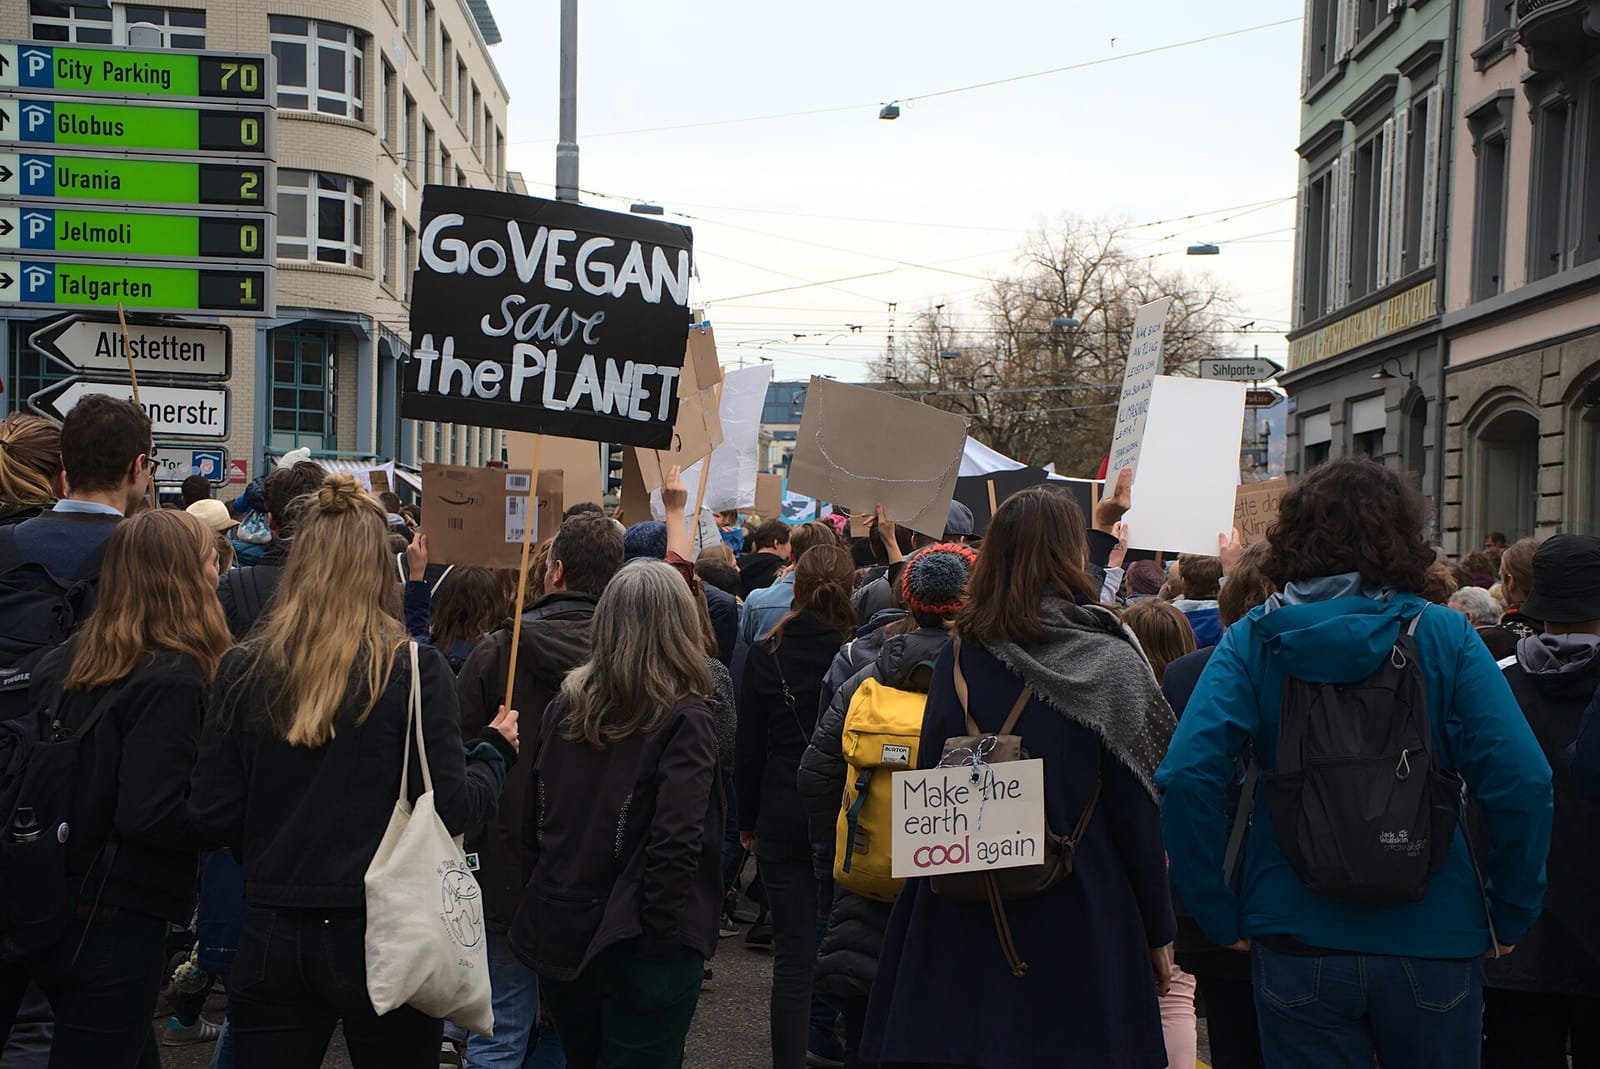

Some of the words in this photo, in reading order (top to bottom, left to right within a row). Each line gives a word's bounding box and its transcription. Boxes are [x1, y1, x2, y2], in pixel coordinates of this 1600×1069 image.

[57, 58, 93, 85] City
[103, 61, 171, 89] Parking
[220, 63, 258, 92] 70
[58, 113, 125, 136] Globus
[241, 118, 258, 145] 0
[58, 167, 121, 190] Urania
[240, 172, 258, 199] 2
[59, 221, 132, 244] Jelmoli
[240, 225, 258, 252] 0
[59, 274, 152, 300] Talgarten
[239, 277, 257, 304] 1
[95, 331, 206, 362] Altstetten
[412, 333, 504, 398] the
[510, 342, 680, 422] PLANET
[1212, 364, 1256, 378] Sihlporte
[904, 776, 969, 810] Make
[979, 770, 1022, 801] the
[904, 807, 968, 835] earth
[913, 835, 970, 868] cool
[977, 830, 1036, 865] again
